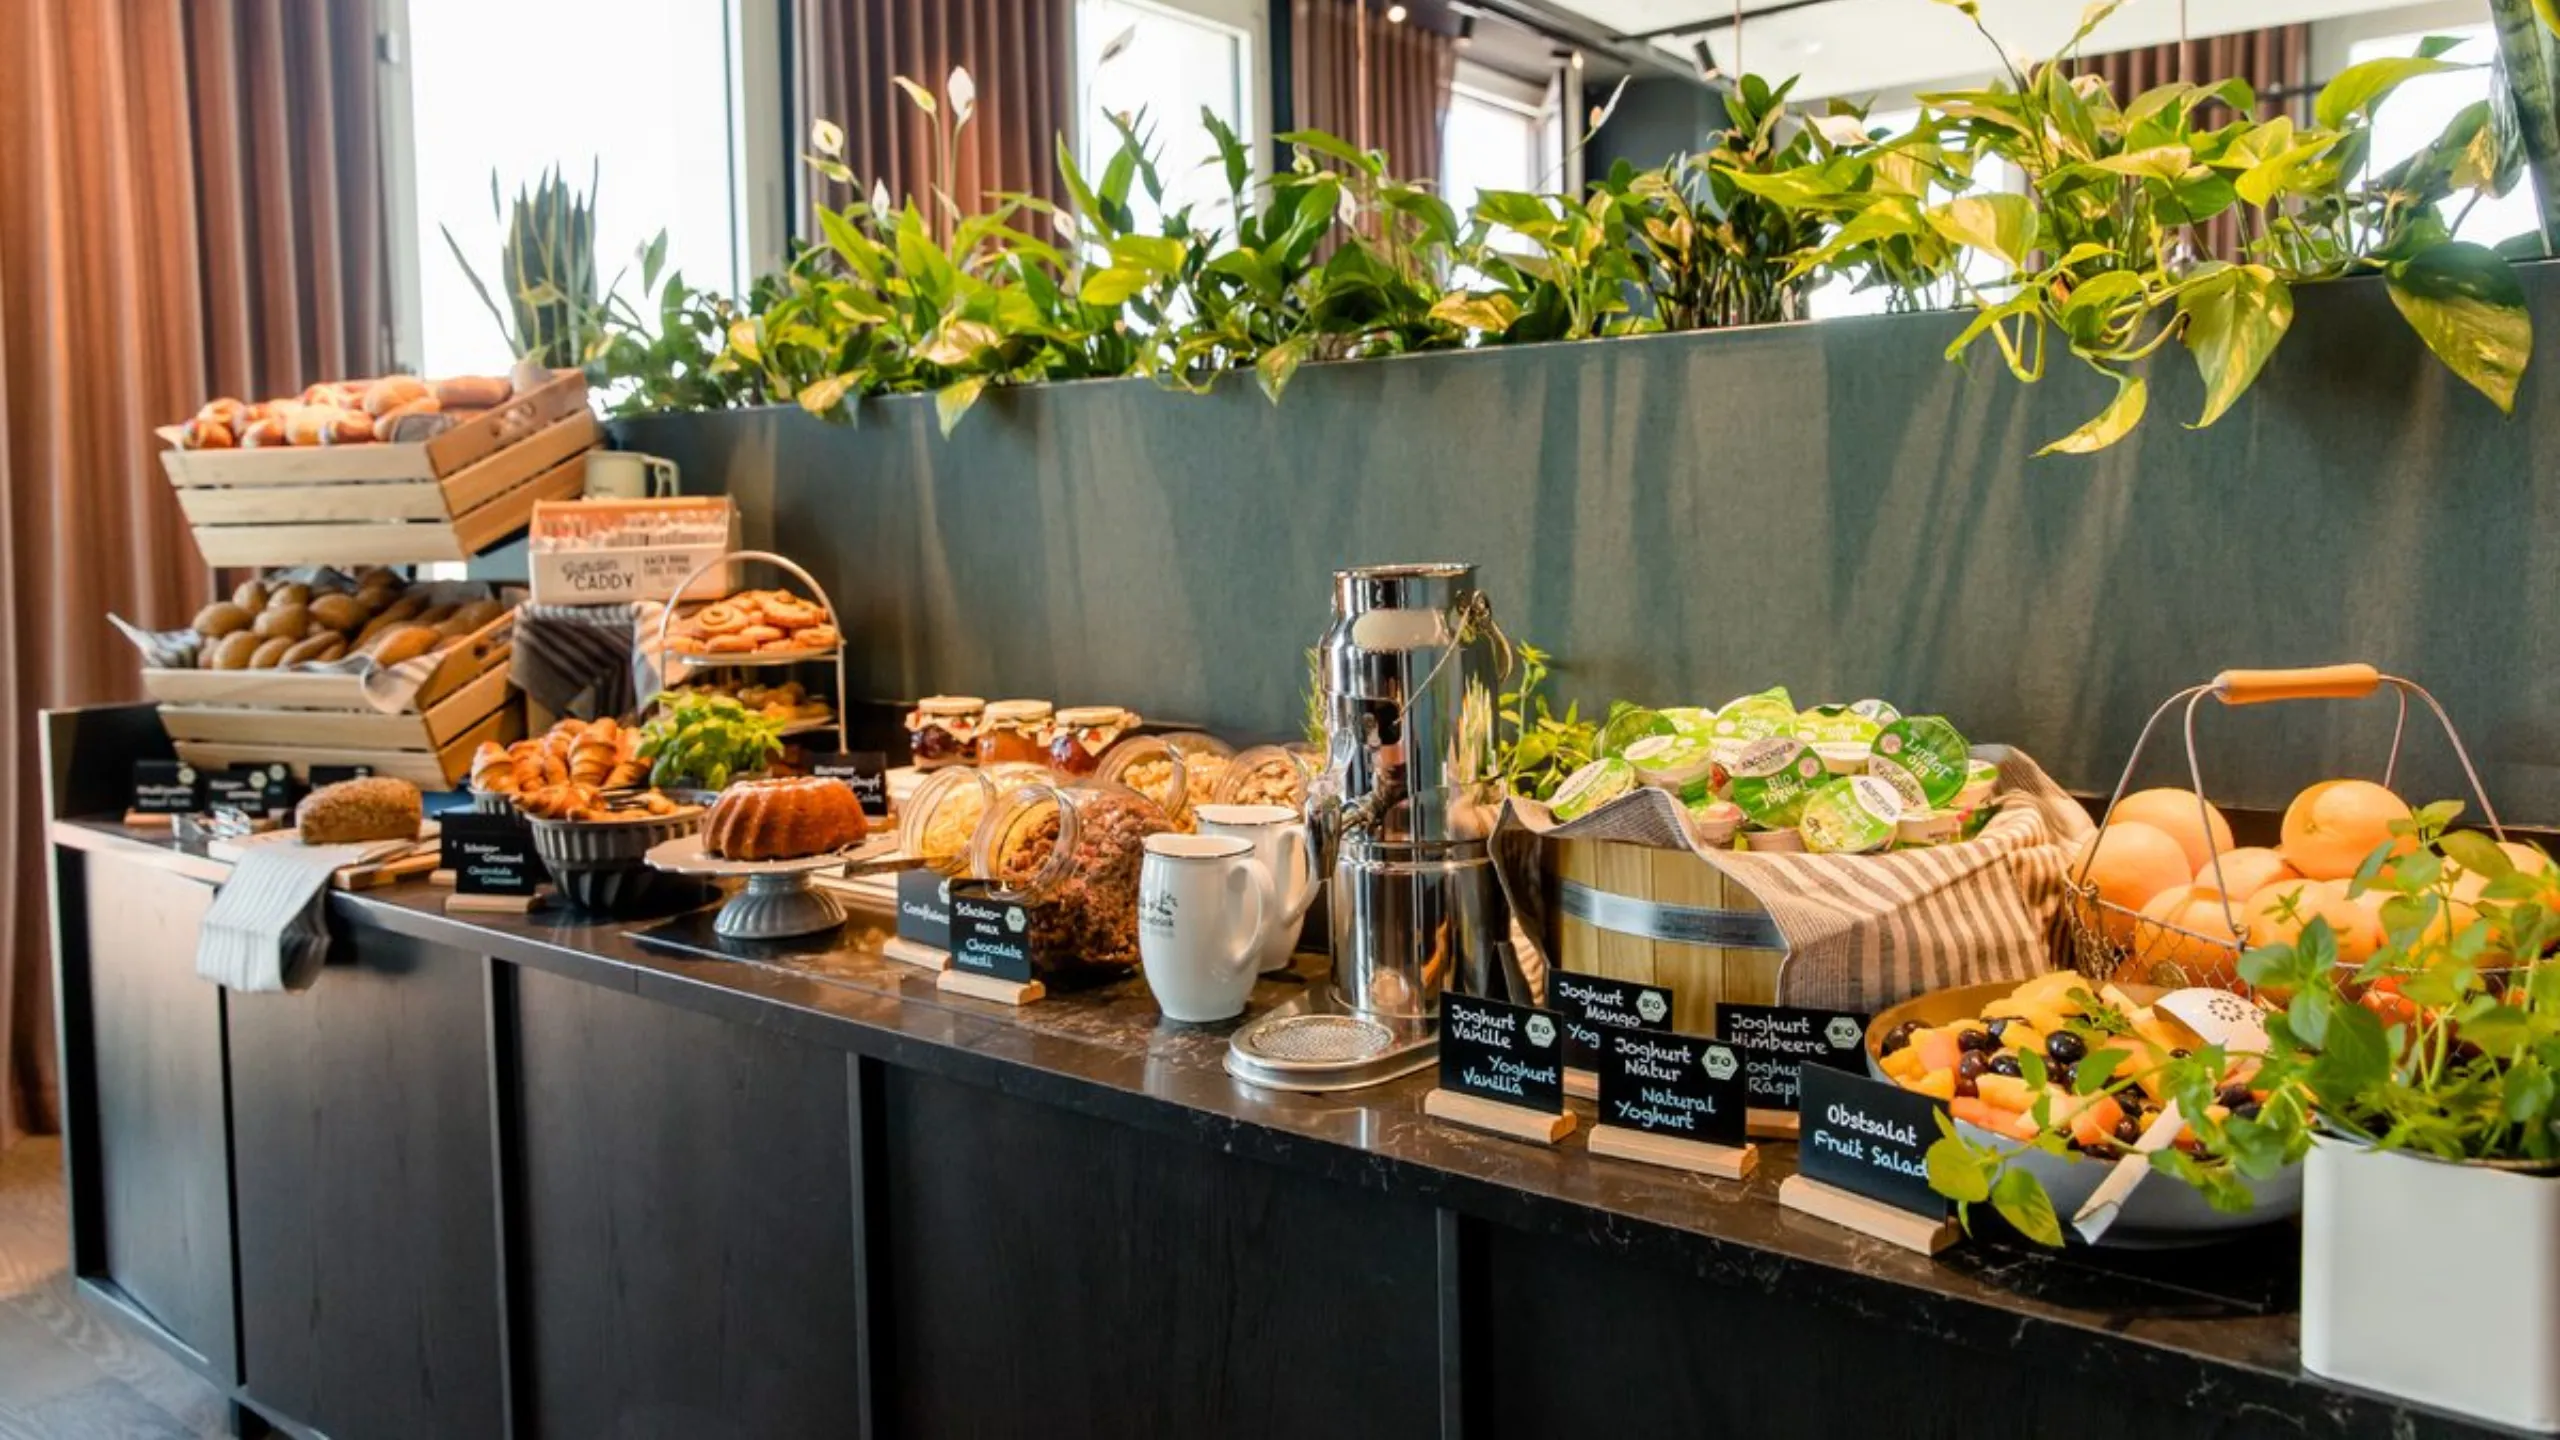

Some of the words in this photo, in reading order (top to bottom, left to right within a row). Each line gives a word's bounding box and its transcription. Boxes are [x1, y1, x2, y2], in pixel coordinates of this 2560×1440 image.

[574, 572, 634, 590] CADDY
[966, 938, 1023, 960] Chocolate
[1559, 982, 1624, 1008] Joghurt
[1451, 1004, 1516, 1031] Joghurt
[1585, 1004, 1641, 1027] Mango
[1730, 1013, 1811, 1038] Joghurt
[1452, 1021, 1512, 1050] Vanille
[1567, 1023, 1600, 1049] Yog
[1731, 1031, 1830, 1055] Himbeere
[1614, 1036, 1692, 1064] Joghurt
[1463, 1066, 1524, 1096] Vanilla
[1488, 1055, 1557, 1085] Yoghurt
[1625, 1059, 1681, 1082] Natur
[1746, 1058, 1801, 1080] oghu
[1642, 1087, 1717, 1114] Natural
[1614, 1100, 1694, 1130] Yoghurt
[1827, 1103, 1917, 1147] Obstsalat
[1814, 1130, 1863, 1159] Fruit
[1871, 1145, 1929, 1179] Salad
